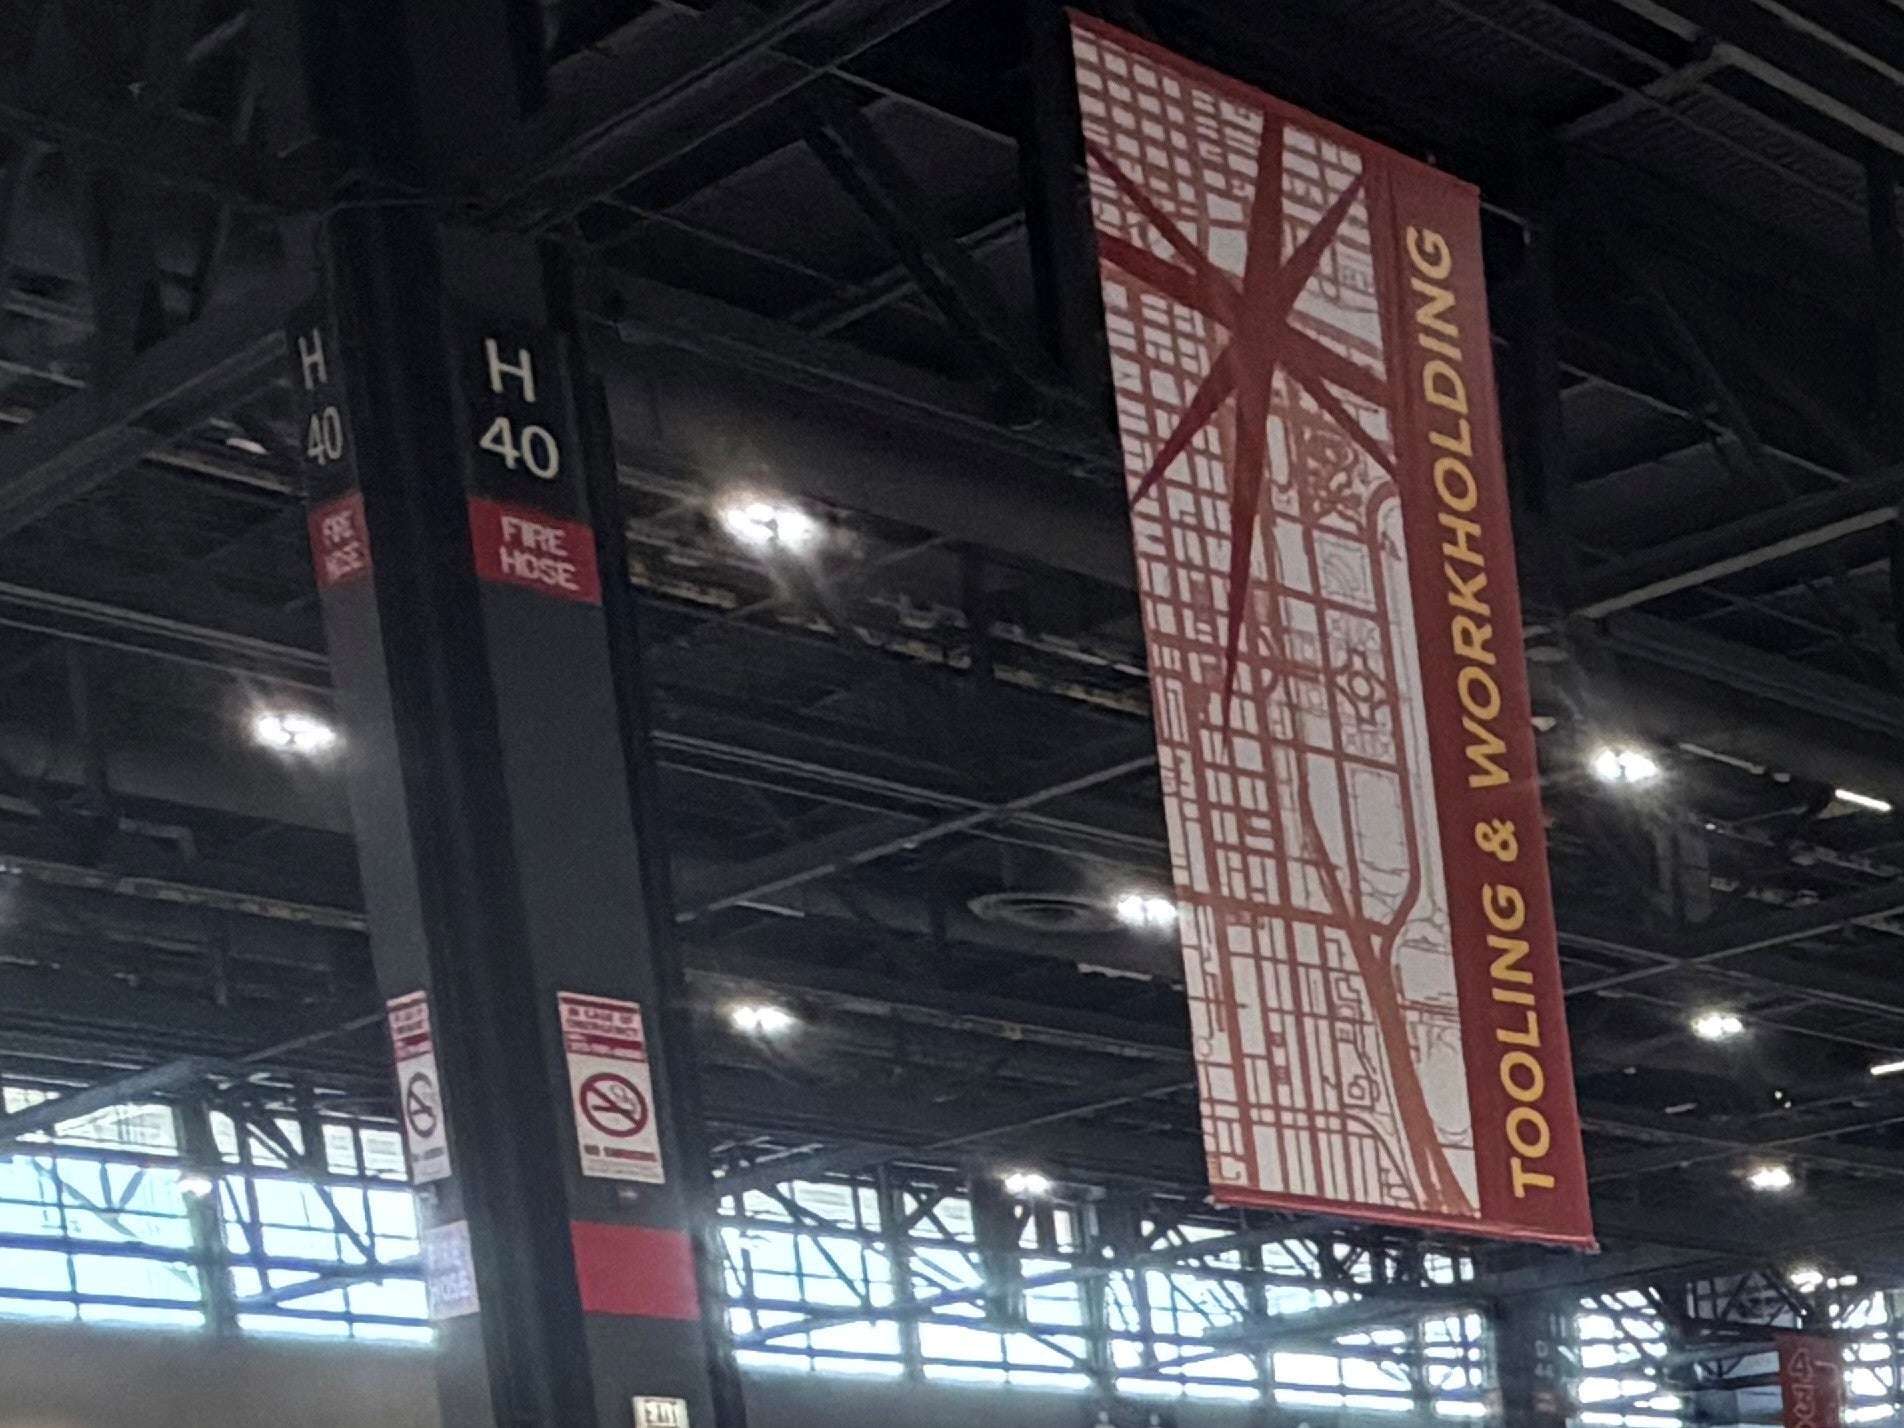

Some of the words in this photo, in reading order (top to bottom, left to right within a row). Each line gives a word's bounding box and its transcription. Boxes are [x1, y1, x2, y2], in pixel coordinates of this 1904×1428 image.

[298, 328, 327, 391] H
[484, 337, 536, 403] H
[305, 405, 343, 466] 40
[479, 416, 560, 481] 40
[500, 514, 568, 559] FIRE
[1405, 224, 1512, 790] WORKHOLDING
[500, 545, 580, 592] HOSE
[1473, 818, 1520, 862] &
[1483, 886, 1556, 1198] TOOLING
